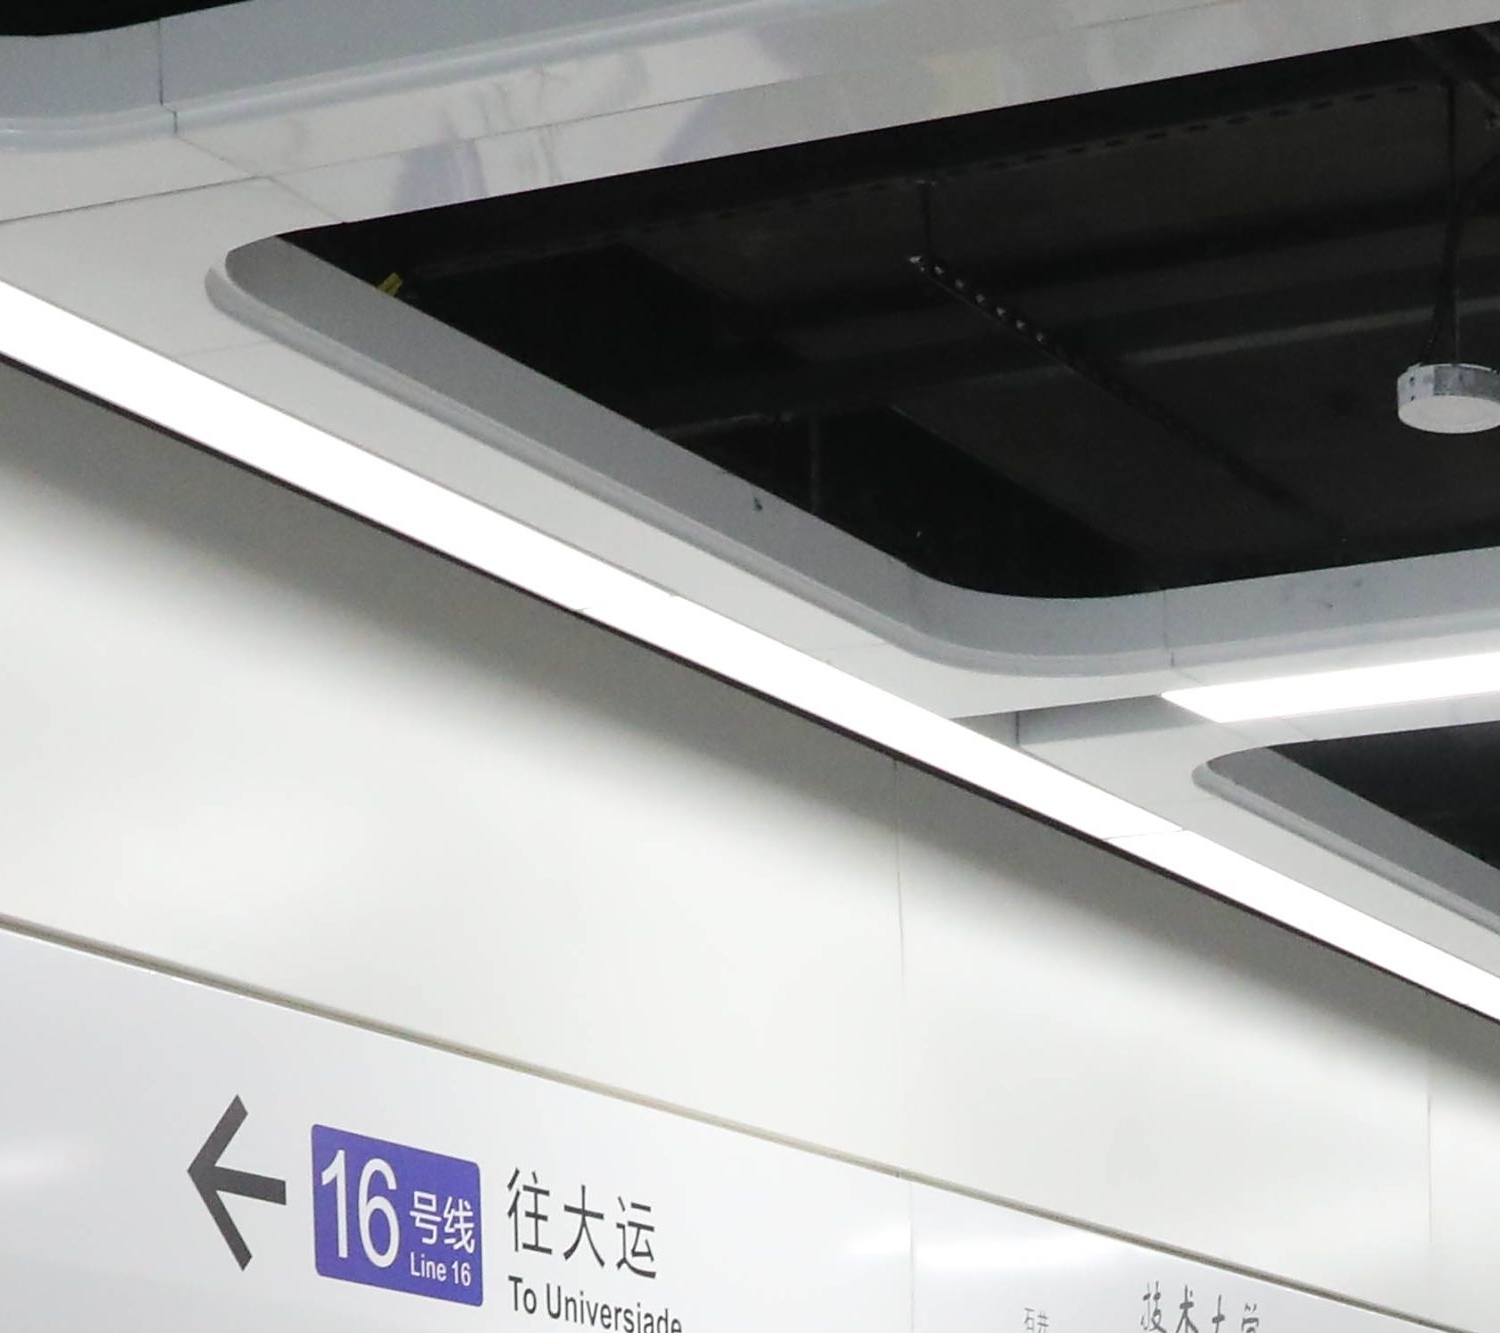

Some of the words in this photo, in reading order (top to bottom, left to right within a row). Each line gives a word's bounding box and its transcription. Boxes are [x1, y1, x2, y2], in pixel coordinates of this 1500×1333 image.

[506, 1167, 657, 1279] 往大运
[410, 1251, 448, 1283] Line
[451, 1259, 472, 1287] 16
[507, 1274, 537, 1314] To
